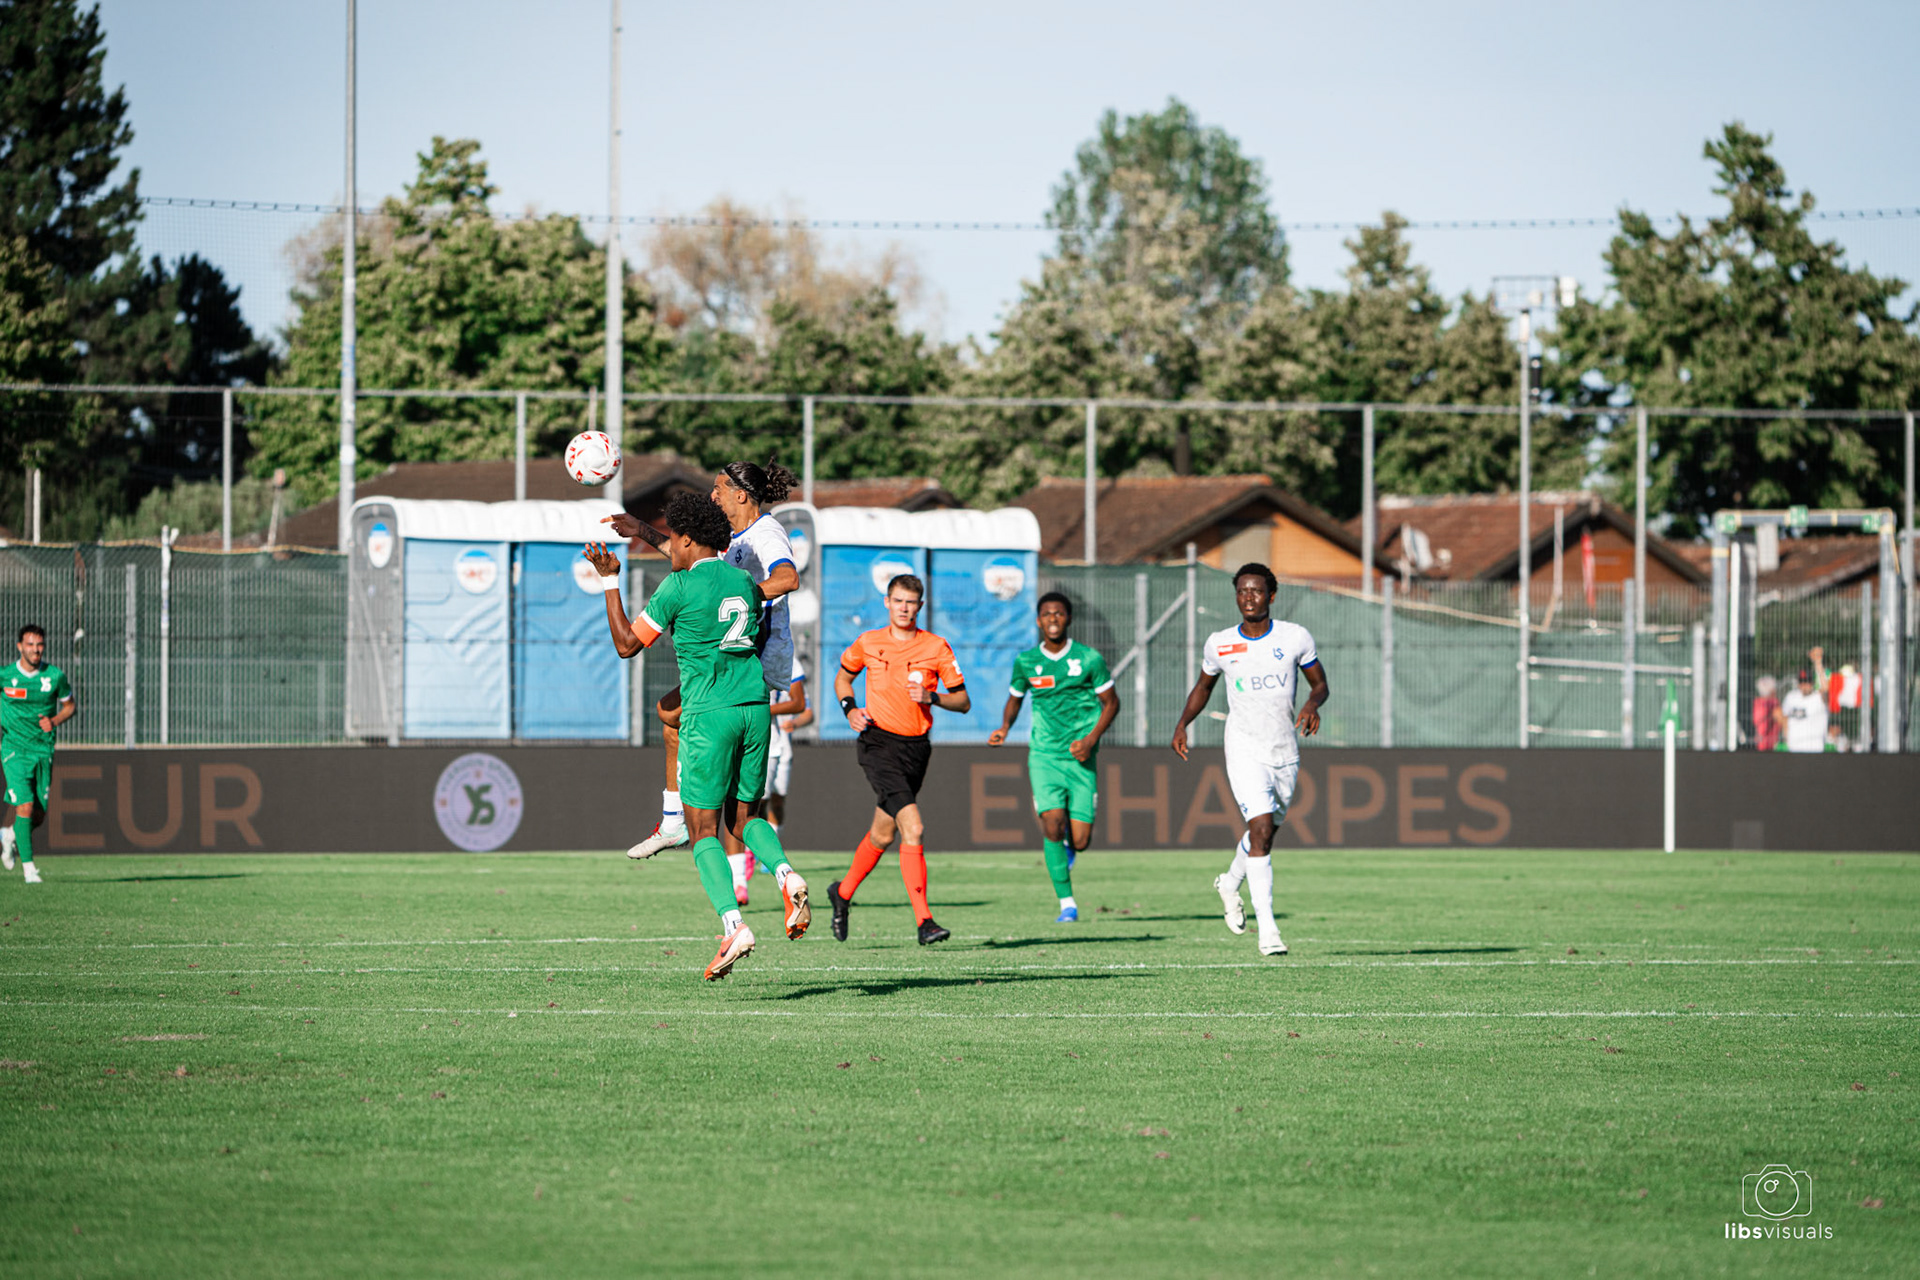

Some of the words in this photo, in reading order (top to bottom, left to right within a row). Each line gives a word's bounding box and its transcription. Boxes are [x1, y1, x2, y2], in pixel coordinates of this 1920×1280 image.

[718, 596, 754, 650] 2
[1250, 673, 1298, 691] BCV
[4, 764, 263, 848] EUR
[971, 763, 1512, 844] EHARPES
